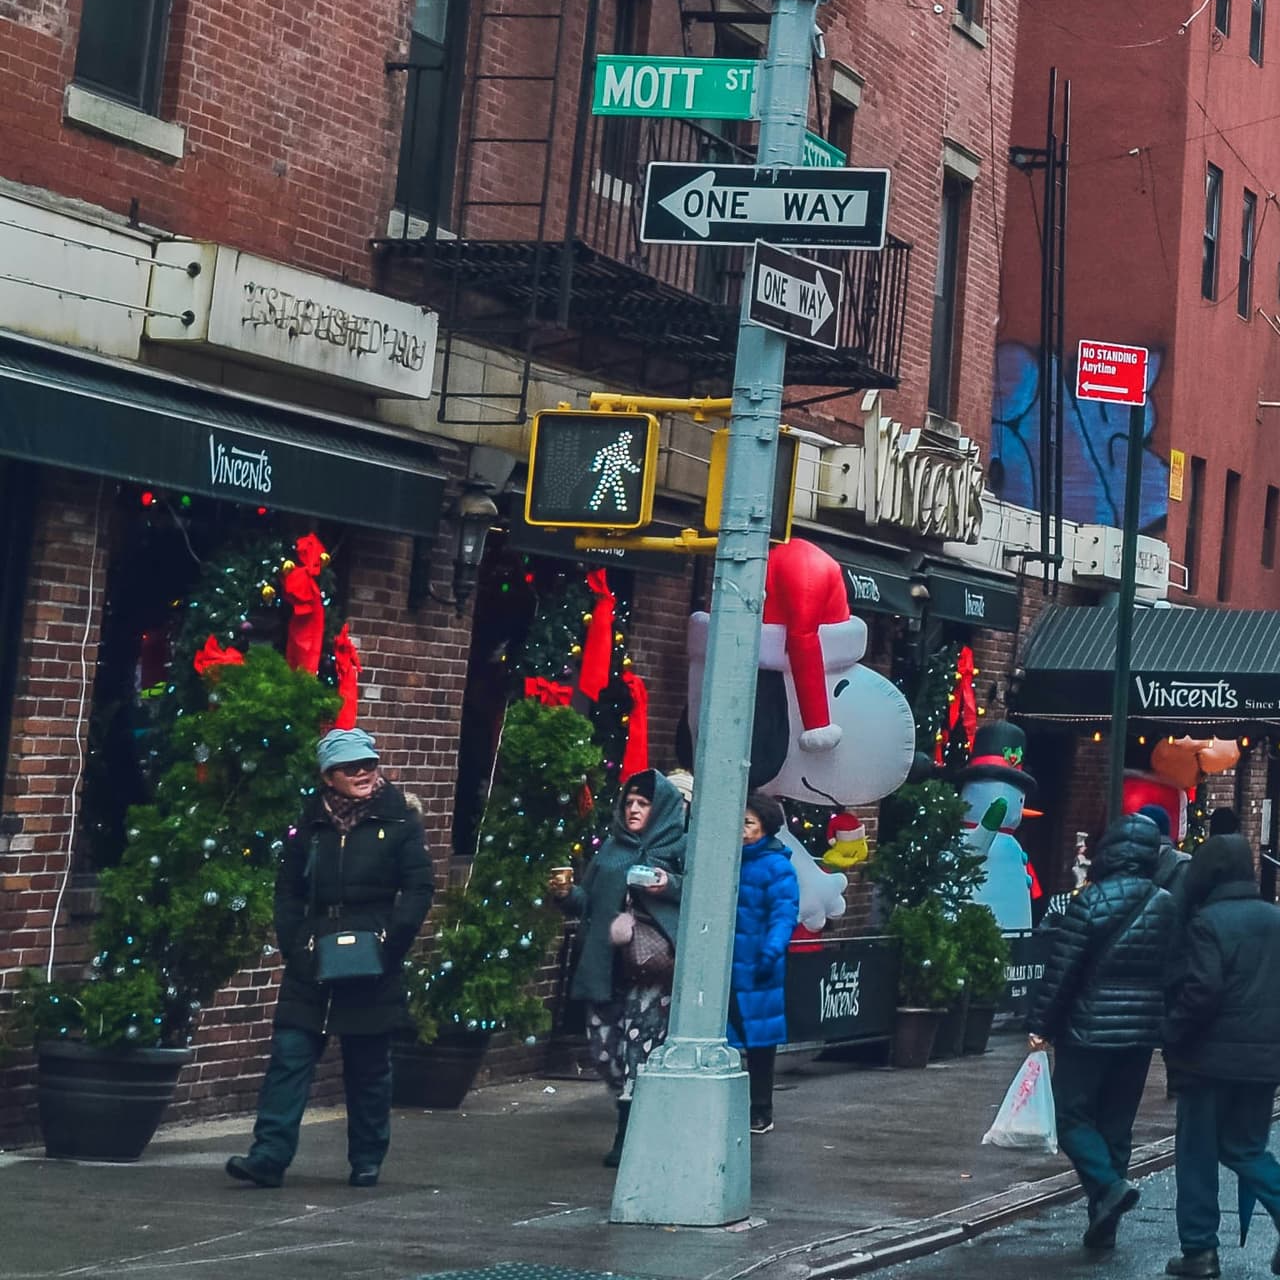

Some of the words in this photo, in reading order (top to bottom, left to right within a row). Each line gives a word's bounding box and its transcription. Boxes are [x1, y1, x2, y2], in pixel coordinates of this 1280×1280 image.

[602, 65, 703, 109] MOTT
[725, 69, 751, 90] ST
[684, 189, 749, 219] ONE
[783, 192, 854, 223] WAY
[764, 272, 788, 308] ONE
[800, 284, 826, 320] WAY
[1082, 347, 1095, 359] NO
[1097, 349, 1138, 364] STANDING
[1082, 361, 1117, 375] Anytime
[209, 433, 272, 493] Vincent's
[1135, 675, 1239, 709] Vincent's
[1245, 698, 1275, 710] Since
